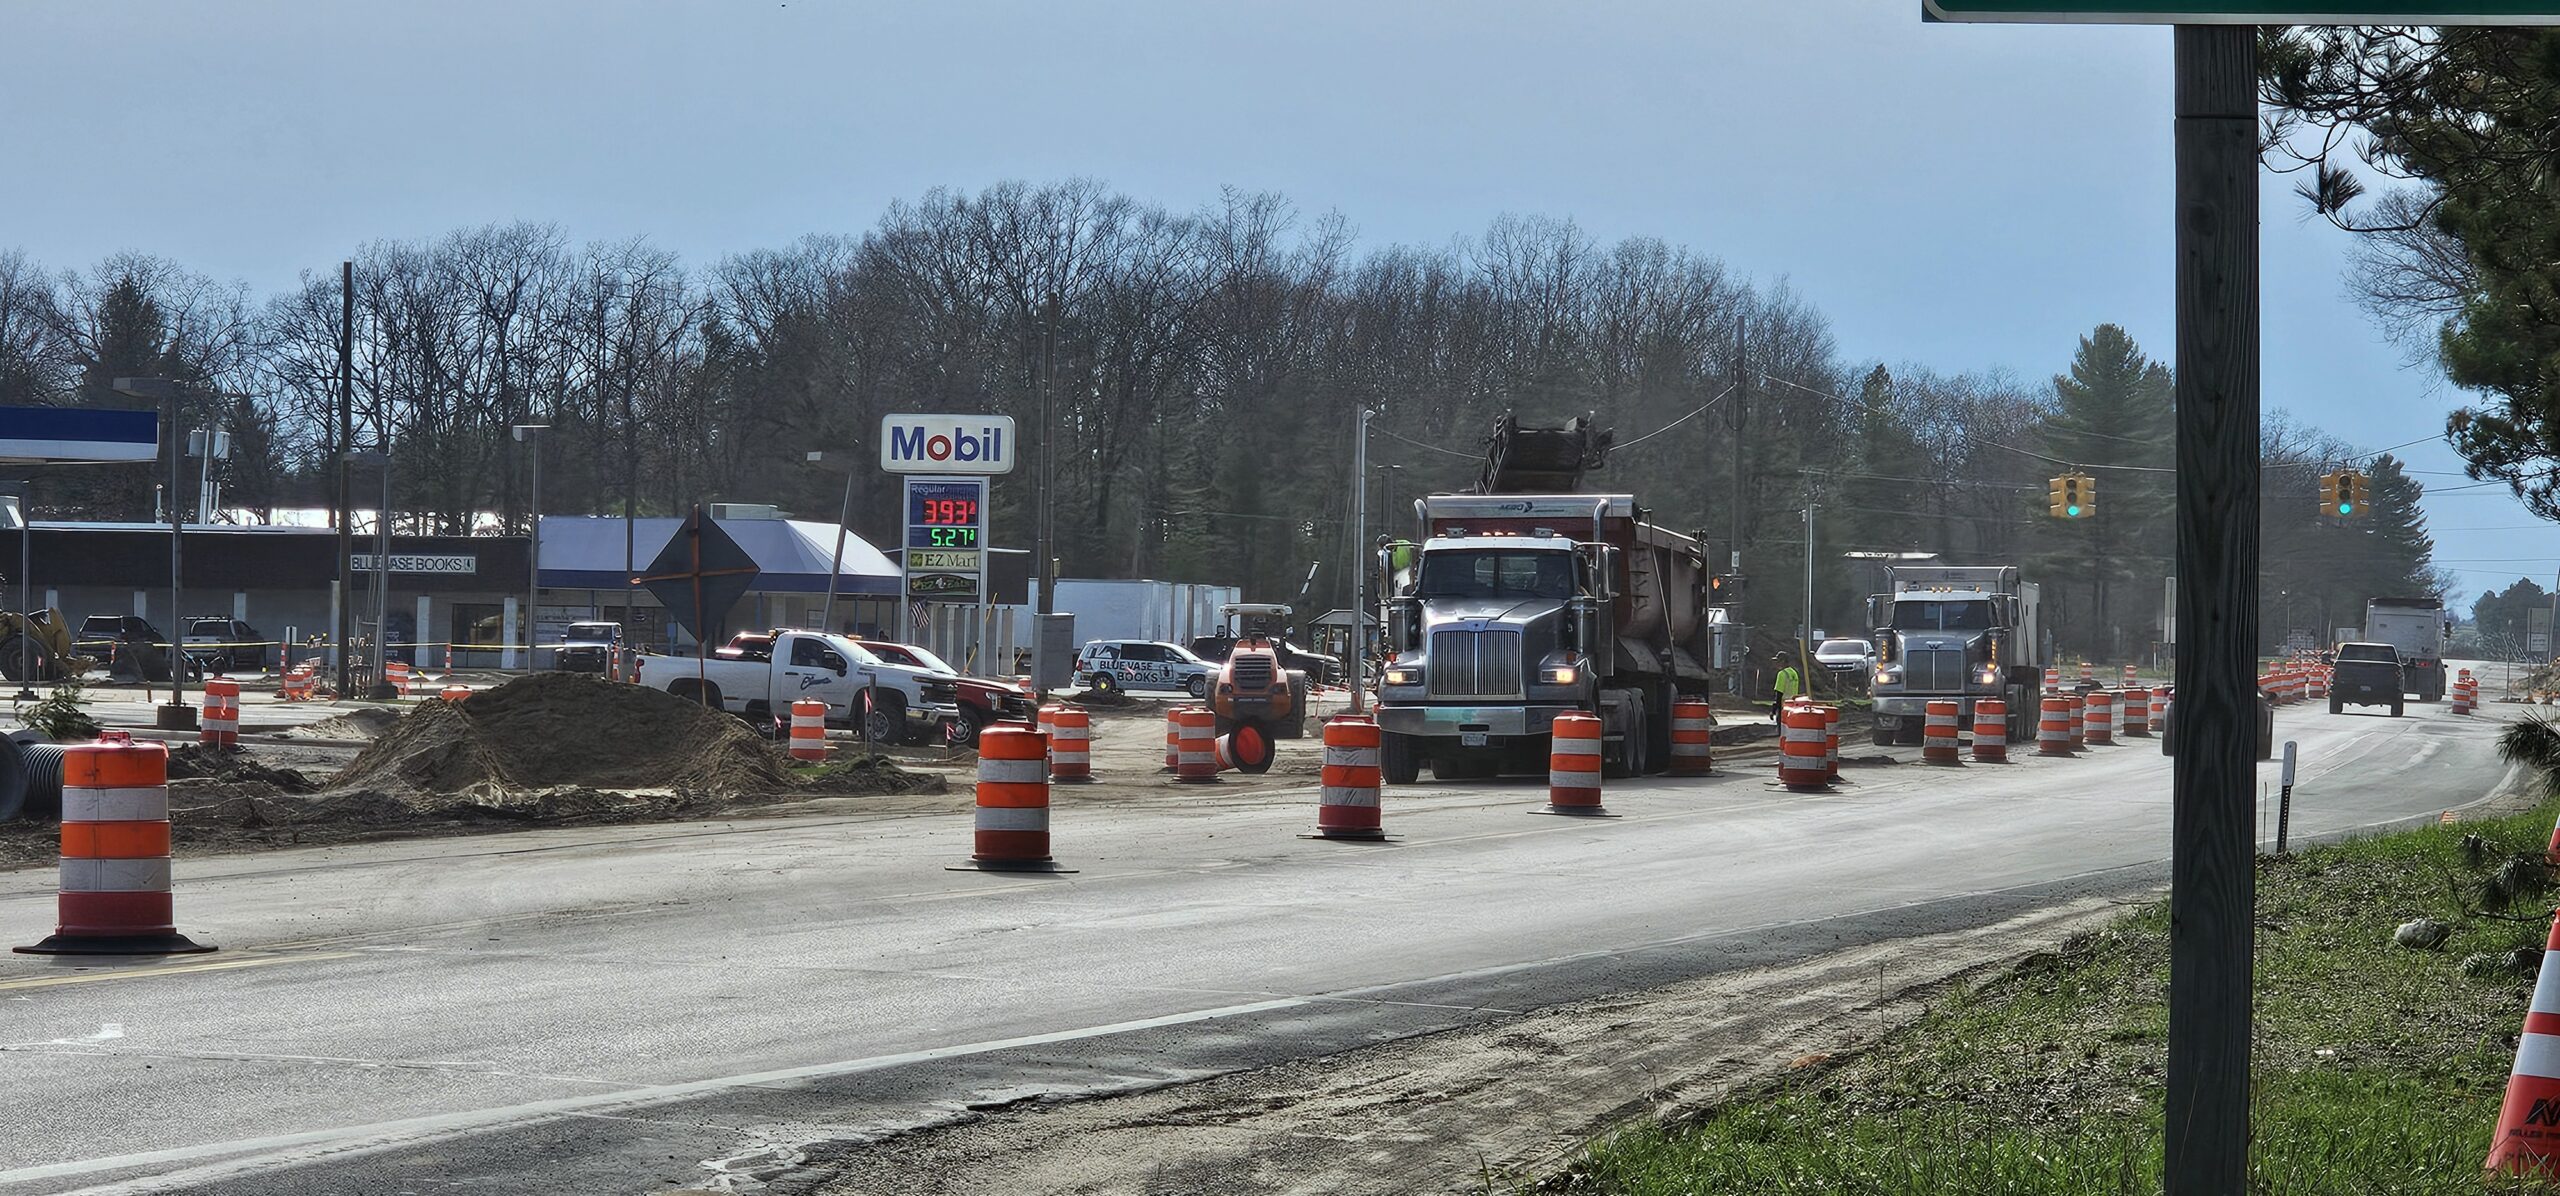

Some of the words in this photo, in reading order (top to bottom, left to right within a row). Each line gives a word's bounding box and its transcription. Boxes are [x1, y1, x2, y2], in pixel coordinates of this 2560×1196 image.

[891, 426, 1001, 461] Mobil
[911, 484, 946, 496] Regular
[387, 557, 414, 570] ASE
[416, 557, 462, 571] BOOKS
[925, 554, 944, 567] EZ
[947, 554, 977, 567] Mart
[1099, 660, 1126, 670] BLUE
[1127, 661, 1153, 671] VASE
[1117, 671, 1159, 683] BOOKS
